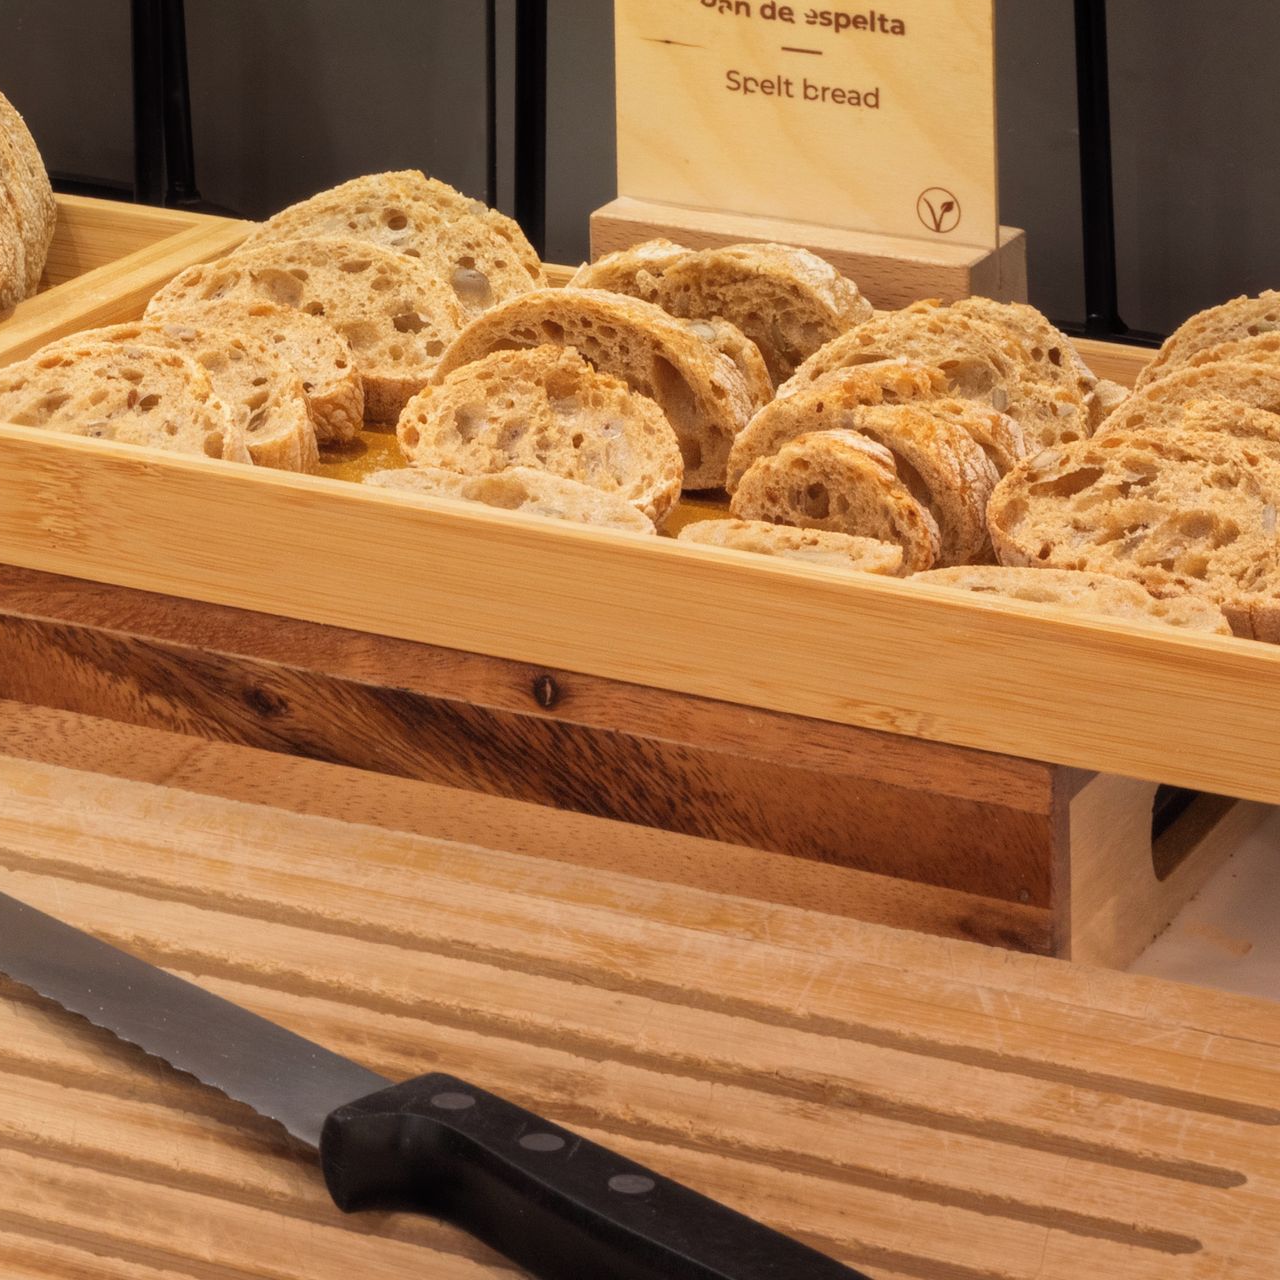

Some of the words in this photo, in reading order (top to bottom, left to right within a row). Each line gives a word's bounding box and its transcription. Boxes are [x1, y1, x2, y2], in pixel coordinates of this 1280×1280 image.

[759, 0, 796, 25] de
[725, 69, 795, 100] Spelt
[802, 78, 881, 110] bread
